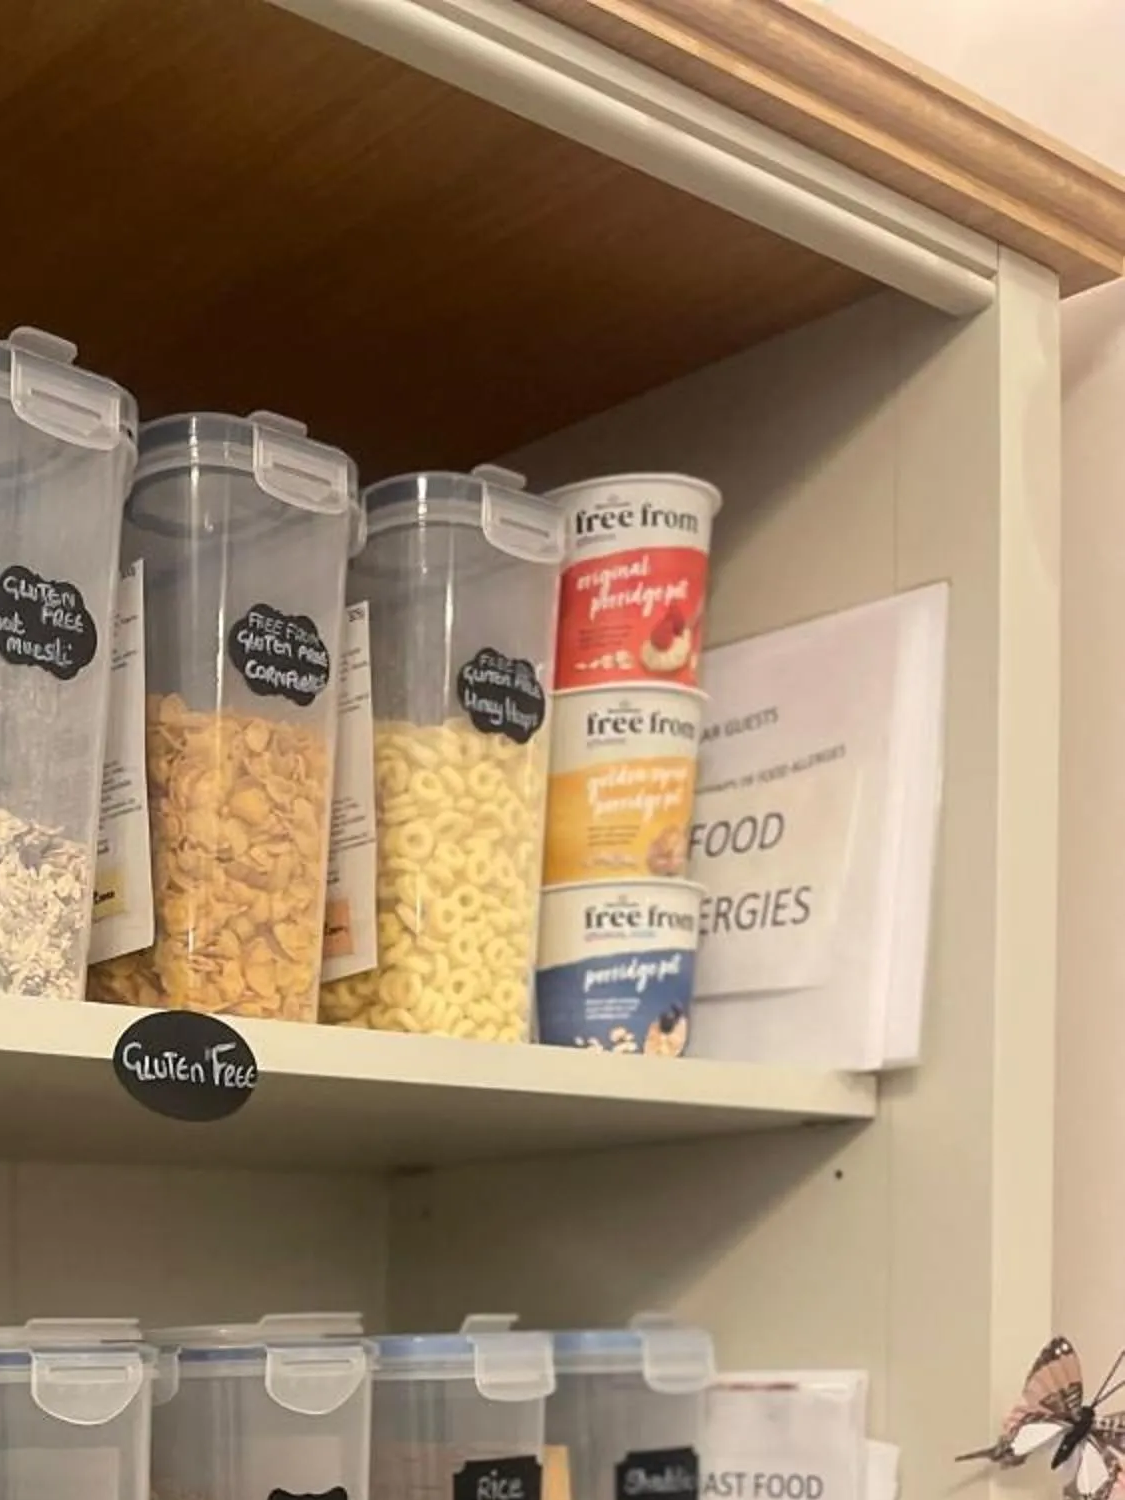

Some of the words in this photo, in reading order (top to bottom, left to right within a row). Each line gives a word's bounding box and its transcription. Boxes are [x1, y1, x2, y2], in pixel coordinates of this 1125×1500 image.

[576, 509, 635, 535] free
[640, 502, 700, 535] from
[3, 576, 76, 608] GLUTEN
[42, 605, 84, 633] FREE
[587, 711, 644, 736] free
[650, 709, 696, 740] from
[687, 811, 785, 861] FOOD
[584, 906, 642, 930] free
[648, 905, 695, 932] from
[583, 957, 656, 993] porridge
[657, 953, 683, 982] pot
[753, 1472, 824, 1500] FOOD
